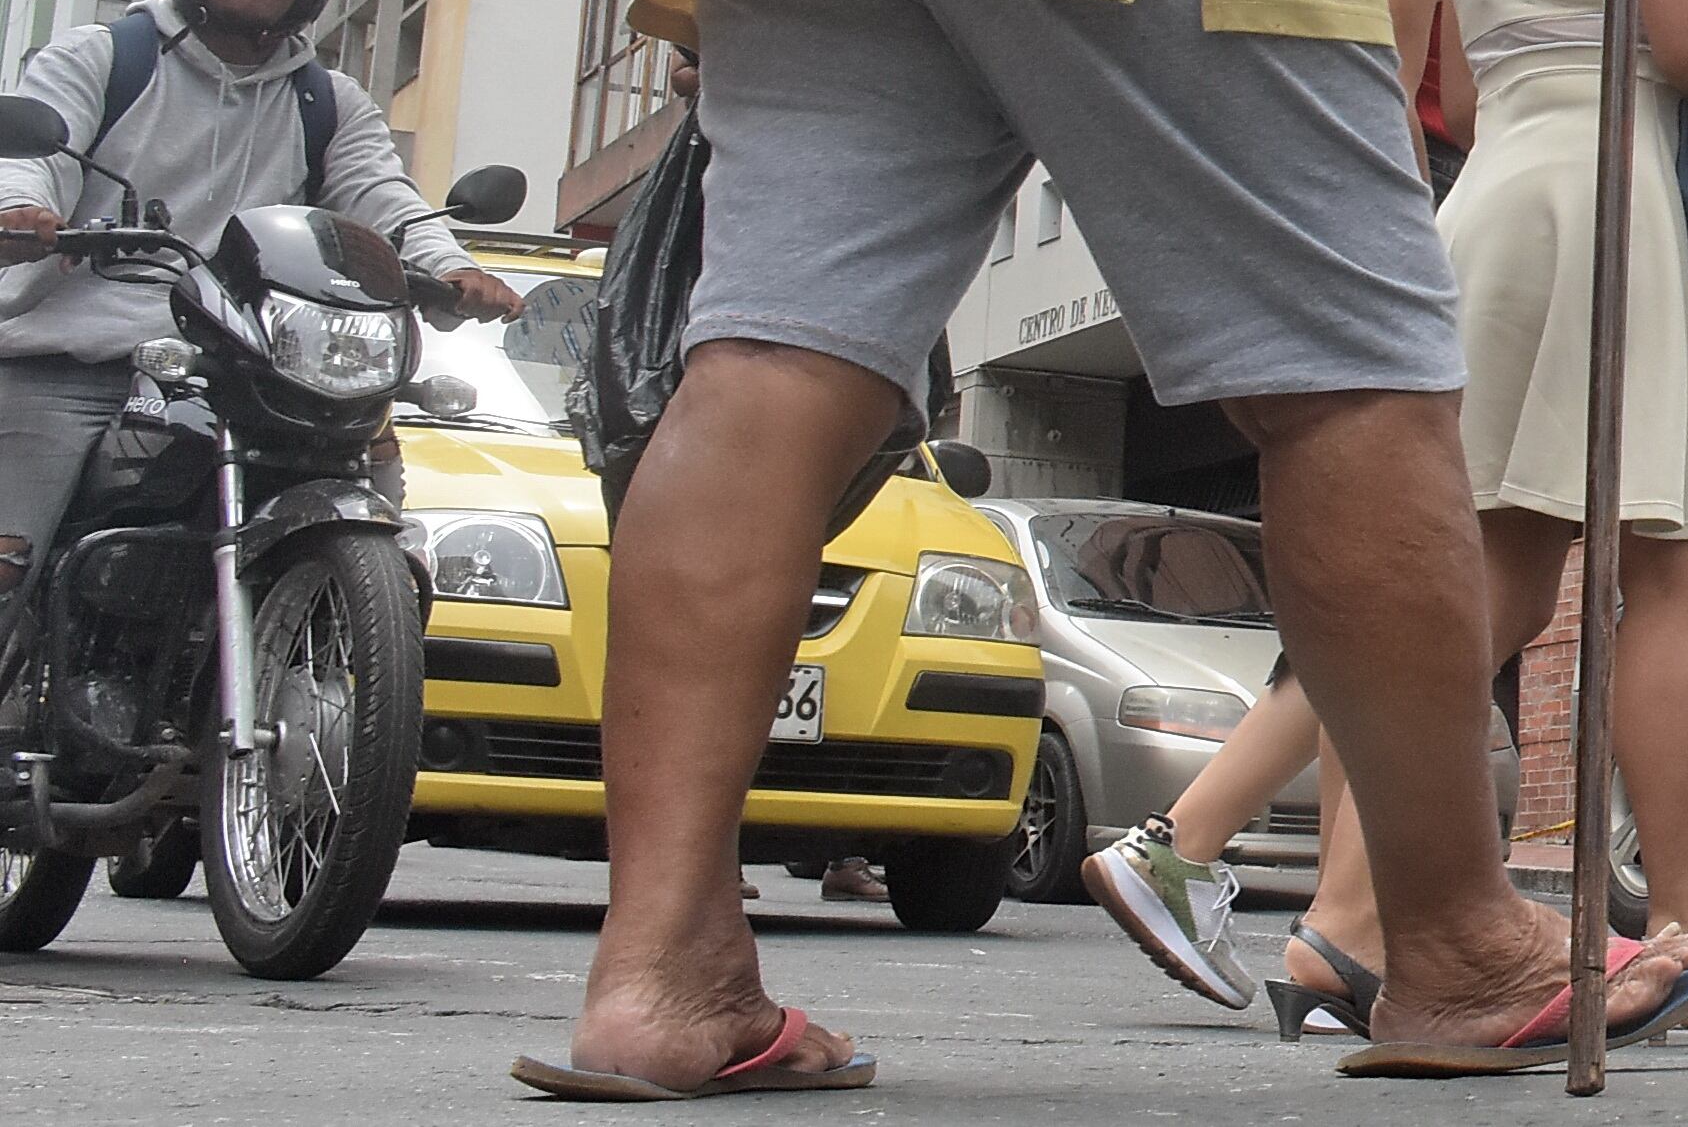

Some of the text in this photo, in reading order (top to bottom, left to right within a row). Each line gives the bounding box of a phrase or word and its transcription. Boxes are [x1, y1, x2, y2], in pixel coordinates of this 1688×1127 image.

[1019, 304, 1065, 344] CENTRO
[1070, 297, 1087, 328] DE
[123, 396, 166, 415] Hero
